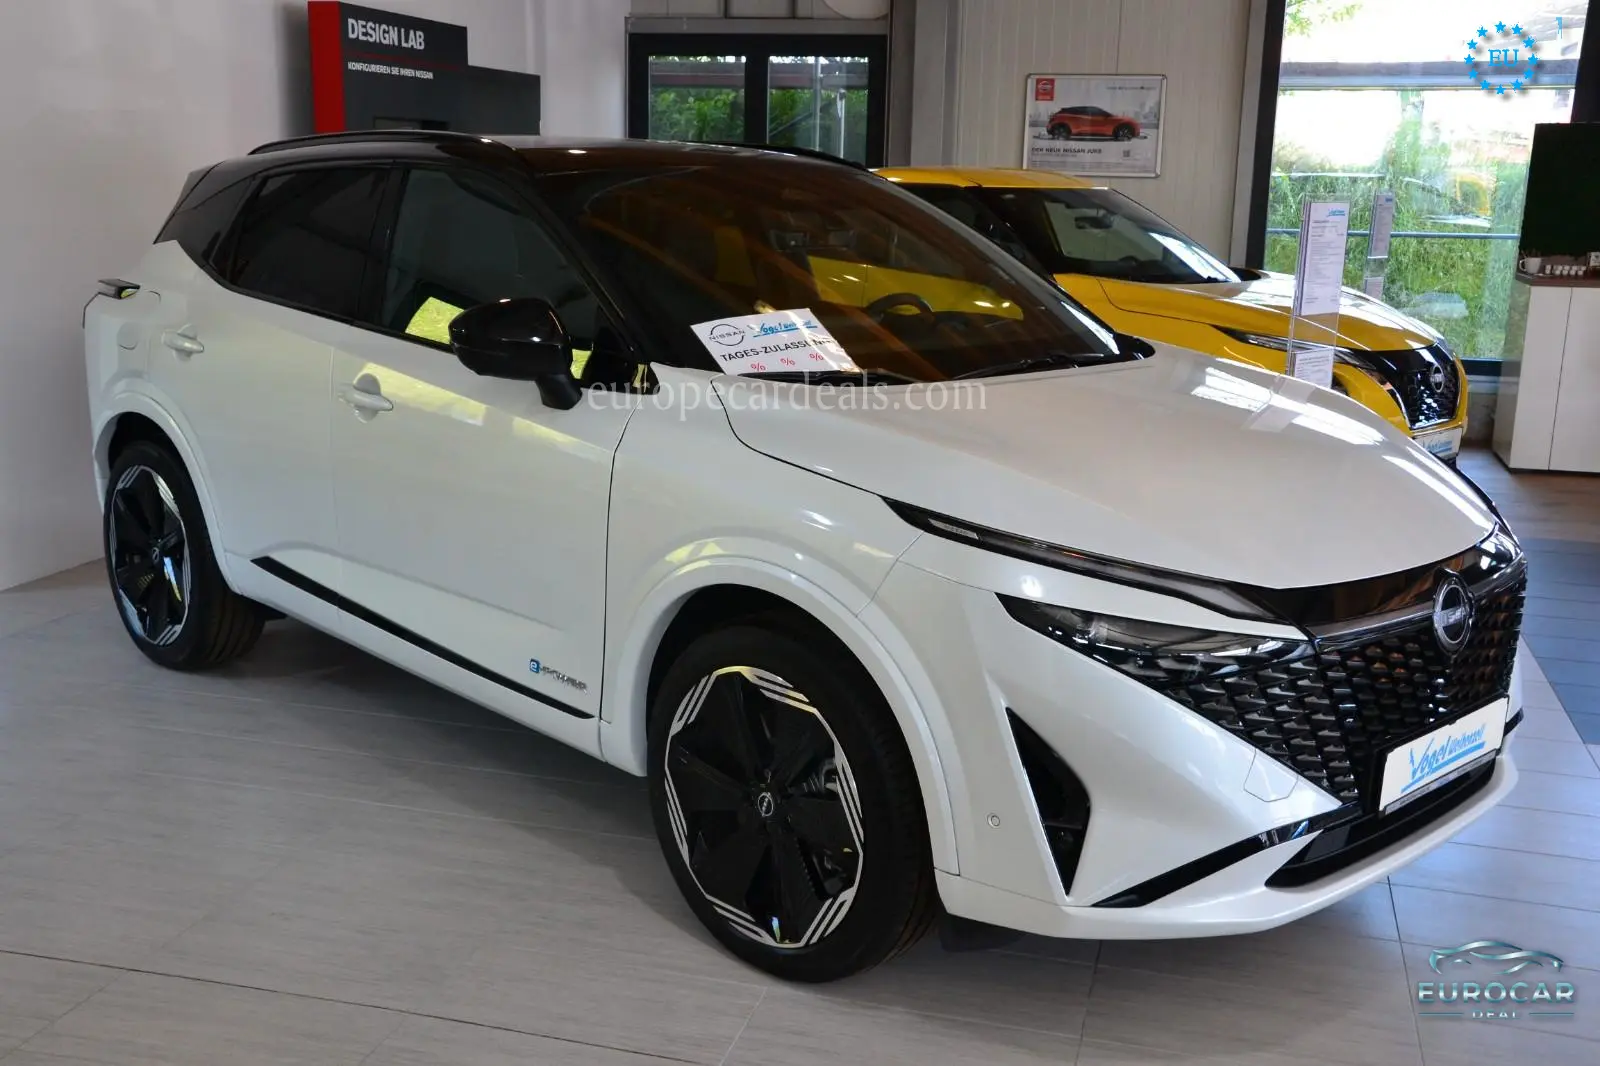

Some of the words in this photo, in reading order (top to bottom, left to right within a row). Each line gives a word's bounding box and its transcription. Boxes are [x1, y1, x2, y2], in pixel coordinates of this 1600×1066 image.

[348, 18, 398, 46] DESIGN
[401, 28, 425, 50] LAB
[347, 61, 391, 75] KONFIGURIEREN
[391, 66, 400, 75] SIE
[400, 68, 415, 77] IHREN
[415, 70, 434, 79] NISSAN
[708, 329, 746, 341] NISSAN
[1409, 736, 1451, 780] Vogel
